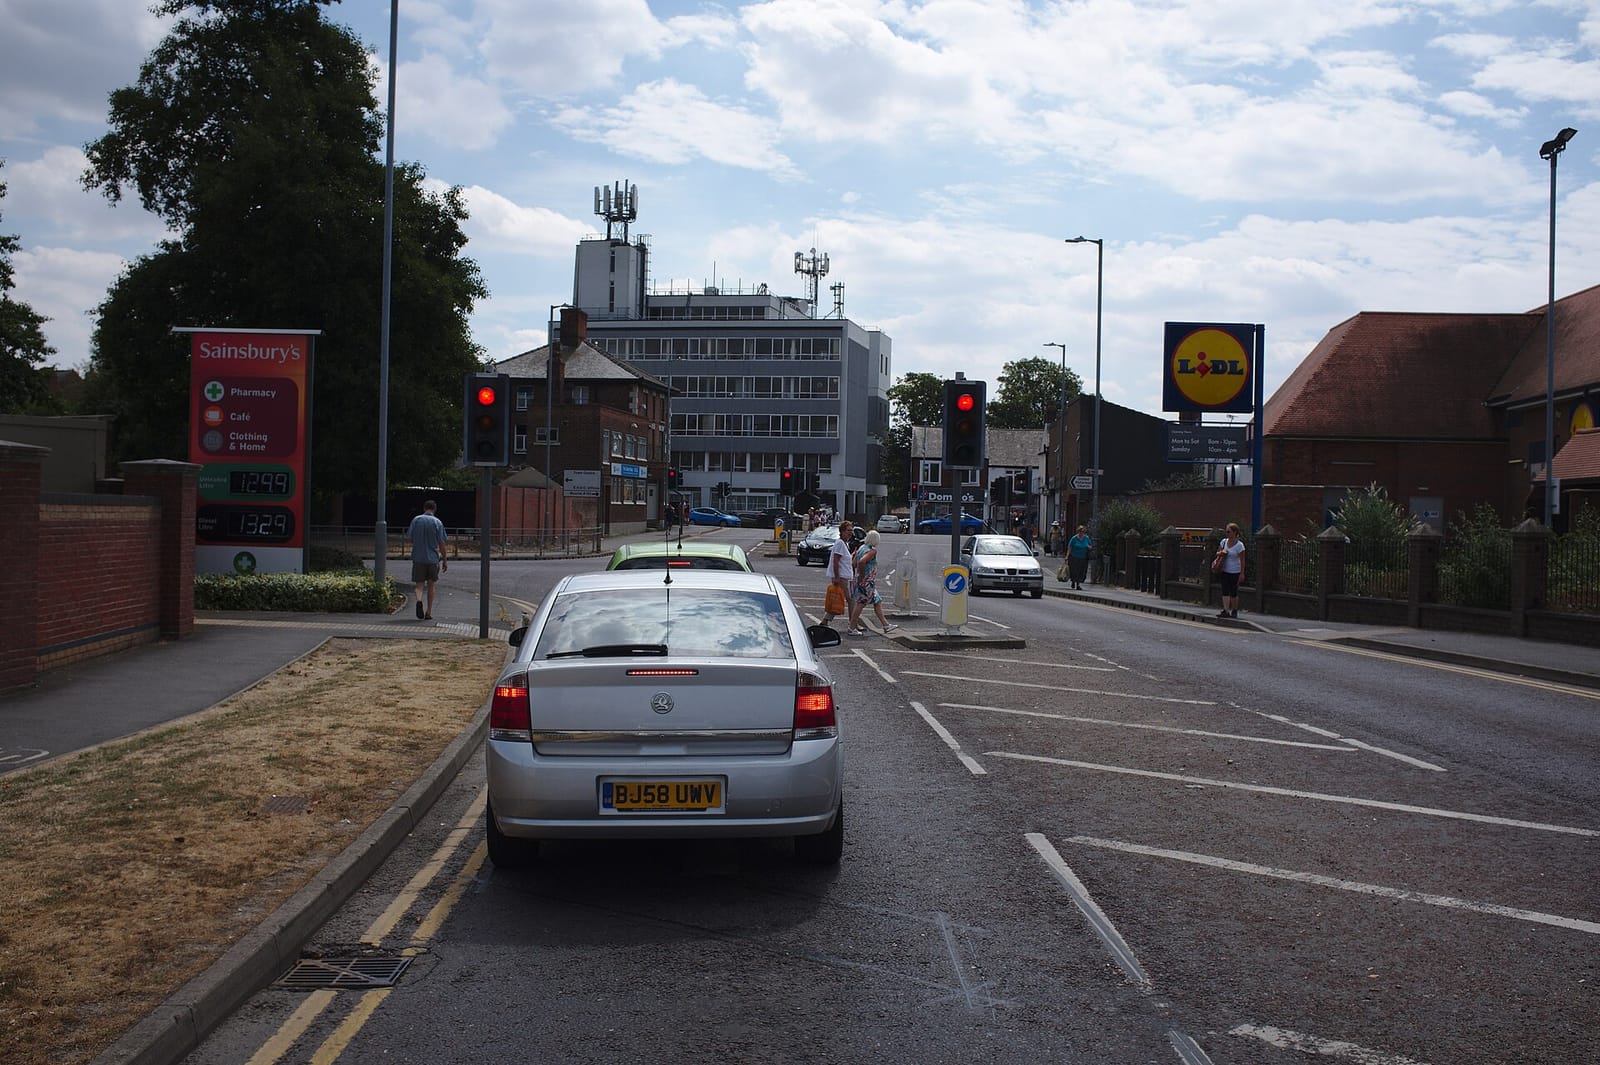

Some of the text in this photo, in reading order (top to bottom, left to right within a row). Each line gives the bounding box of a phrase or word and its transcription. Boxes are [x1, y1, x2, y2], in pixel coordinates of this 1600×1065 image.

[200, 342, 300, 363] Sainsbury's
[230, 388, 276, 398] Pharmacy
[230, 411, 251, 421] Café
[229, 432, 268, 442] Clothing
[229, 442, 266, 451] & Home
[928, 492, 975, 501] Domo's
[615, 784, 716, 804] BJ58 UWV
